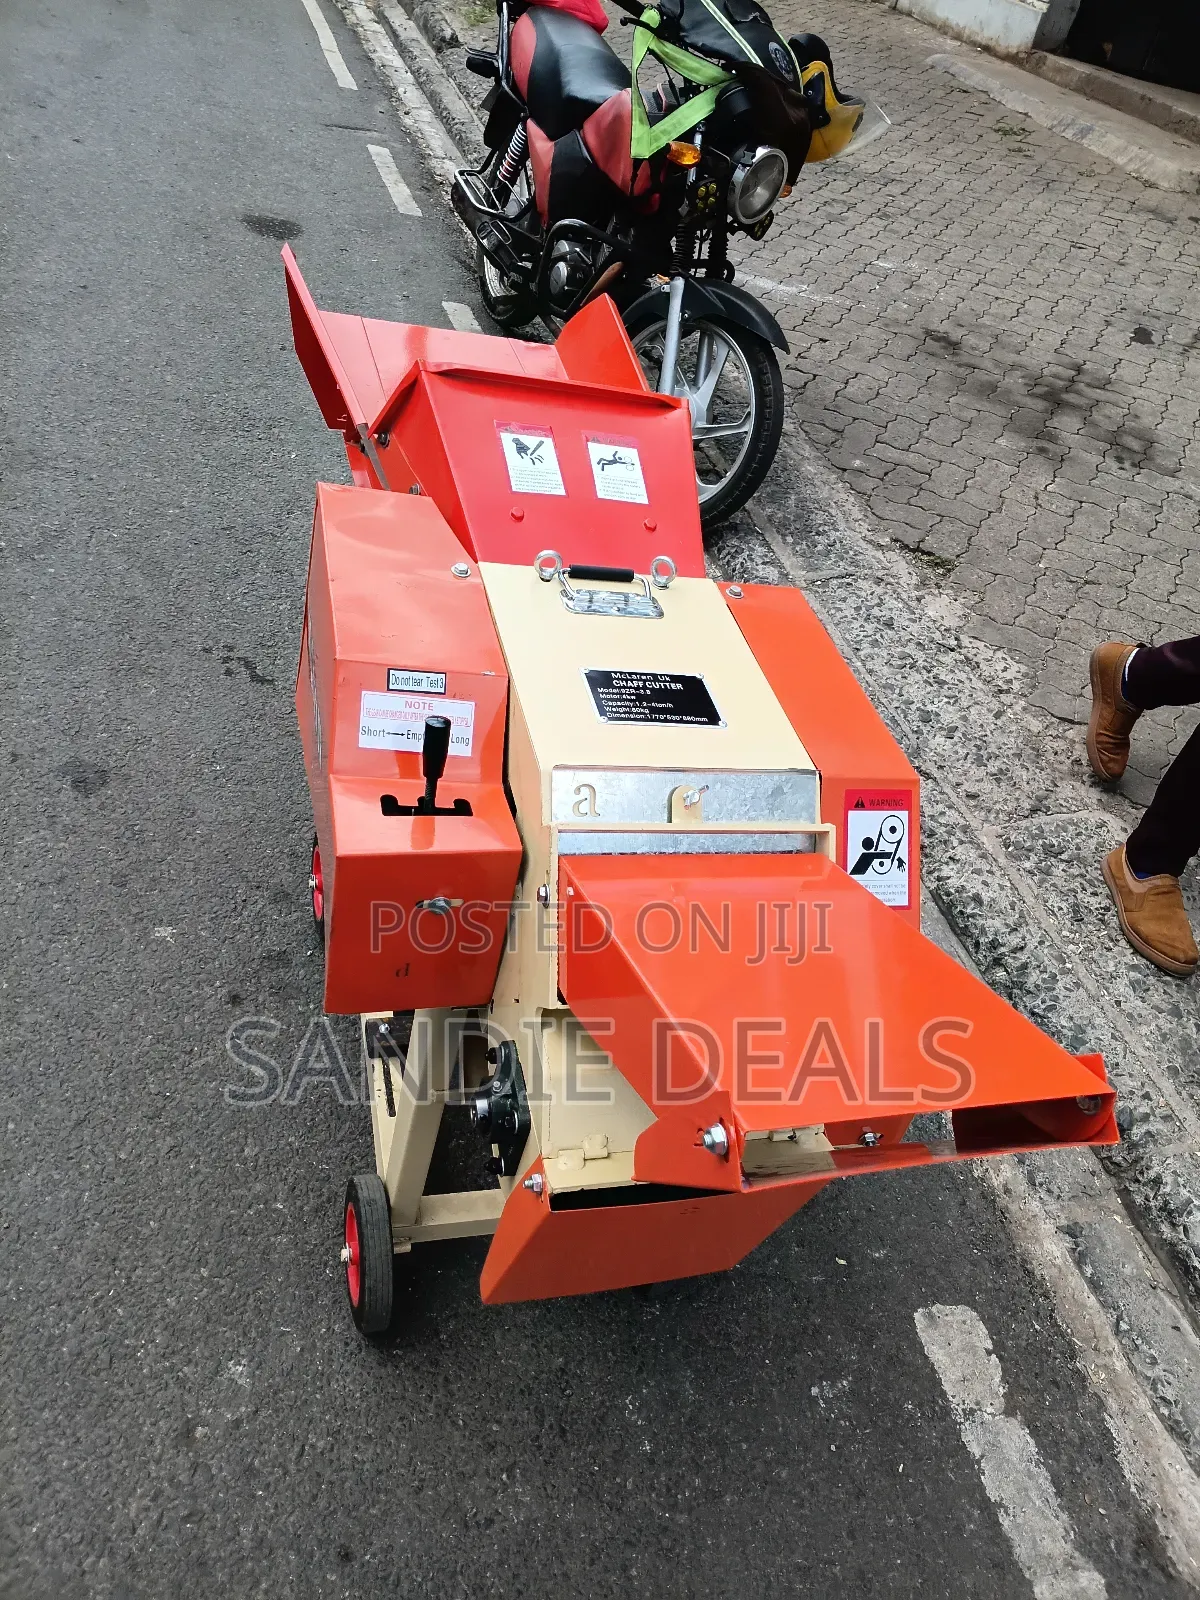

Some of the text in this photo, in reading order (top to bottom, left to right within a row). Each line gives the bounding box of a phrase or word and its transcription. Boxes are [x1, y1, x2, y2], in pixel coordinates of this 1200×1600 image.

[612, 680, 684, 691] CHAFF CUTTER
[404, 700, 434, 711] NOTE
[360, 726, 386, 738] Short
[450, 733, 470, 747] Long
[572, 783, 601, 818] a
[868, 799, 904, 808] WARNING
